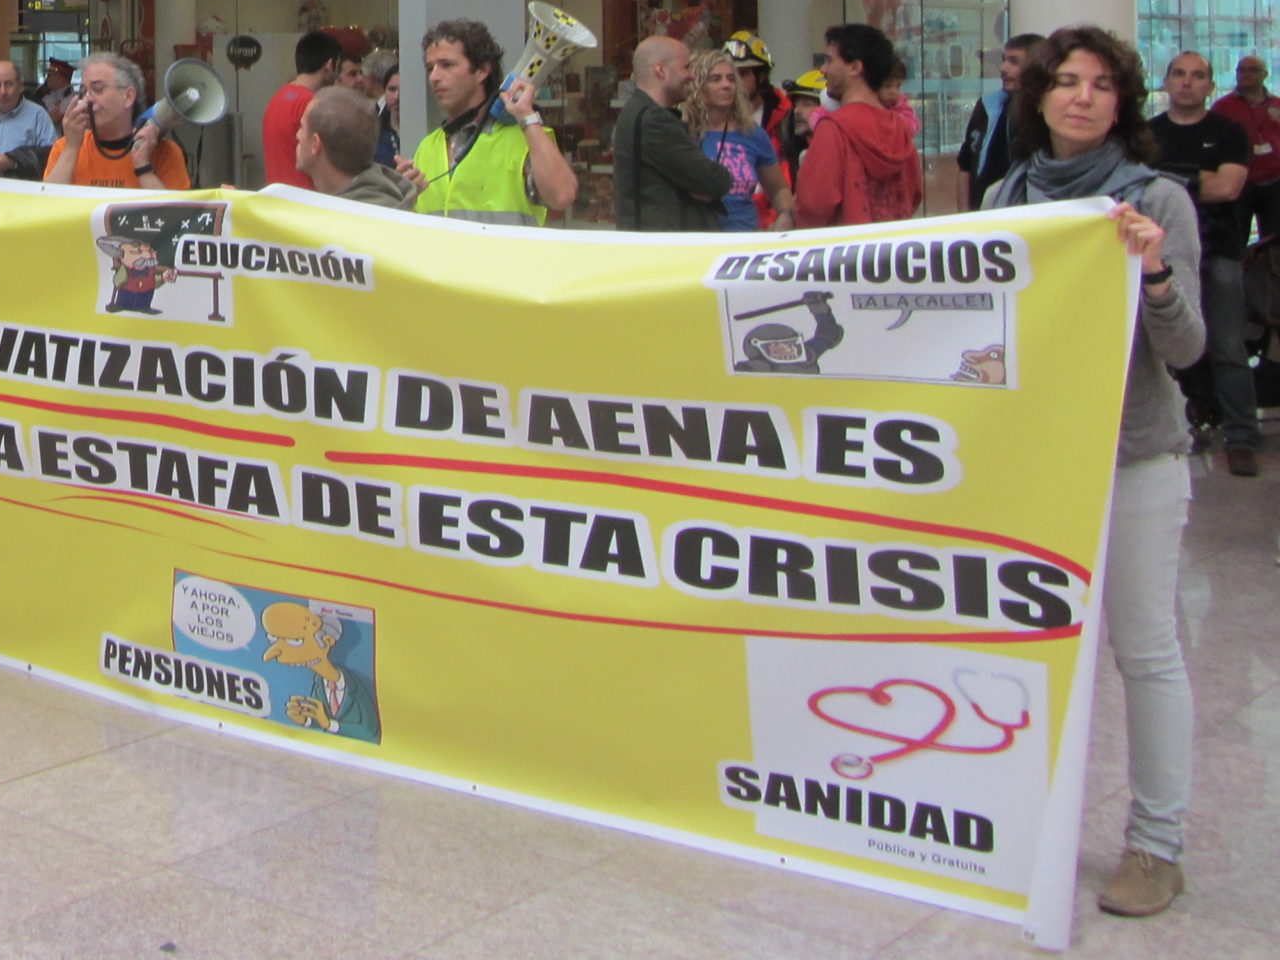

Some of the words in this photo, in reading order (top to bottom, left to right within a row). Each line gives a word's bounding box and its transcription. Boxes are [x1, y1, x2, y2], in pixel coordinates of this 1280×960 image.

[181, 239, 366, 285] EDUCACIÓN
[714, 240, 1016, 283] DESAHUCIOS
[882, 295, 909, 307] LA
[914, 293, 987, 308] CALLE!
[394, 374, 506, 439] DE
[527, 394, 787, 470] AENA
[816, 413, 944, 485] ES
[37, 432, 280, 518] ESTAFA
[300, 471, 396, 540] DE
[418, 491, 647, 579] ESTA
[673, 526, 1072, 630] CRISIS
[181, 584, 189, 595] Y
[190, 589, 241, 609] AHORA,
[190, 601, 199, 611] A
[202, 603, 230, 617] POR
[188, 624, 234, 643] VIEJOS
[197, 614, 223, 628] LOS
[104, 638, 264, 710] PENSIONES
[724, 766, 994, 853] SANIDAD
[868, 839, 916, 858] Pública
[919, 851, 927, 862] y
[931, 853, 986, 874] Gratuita
